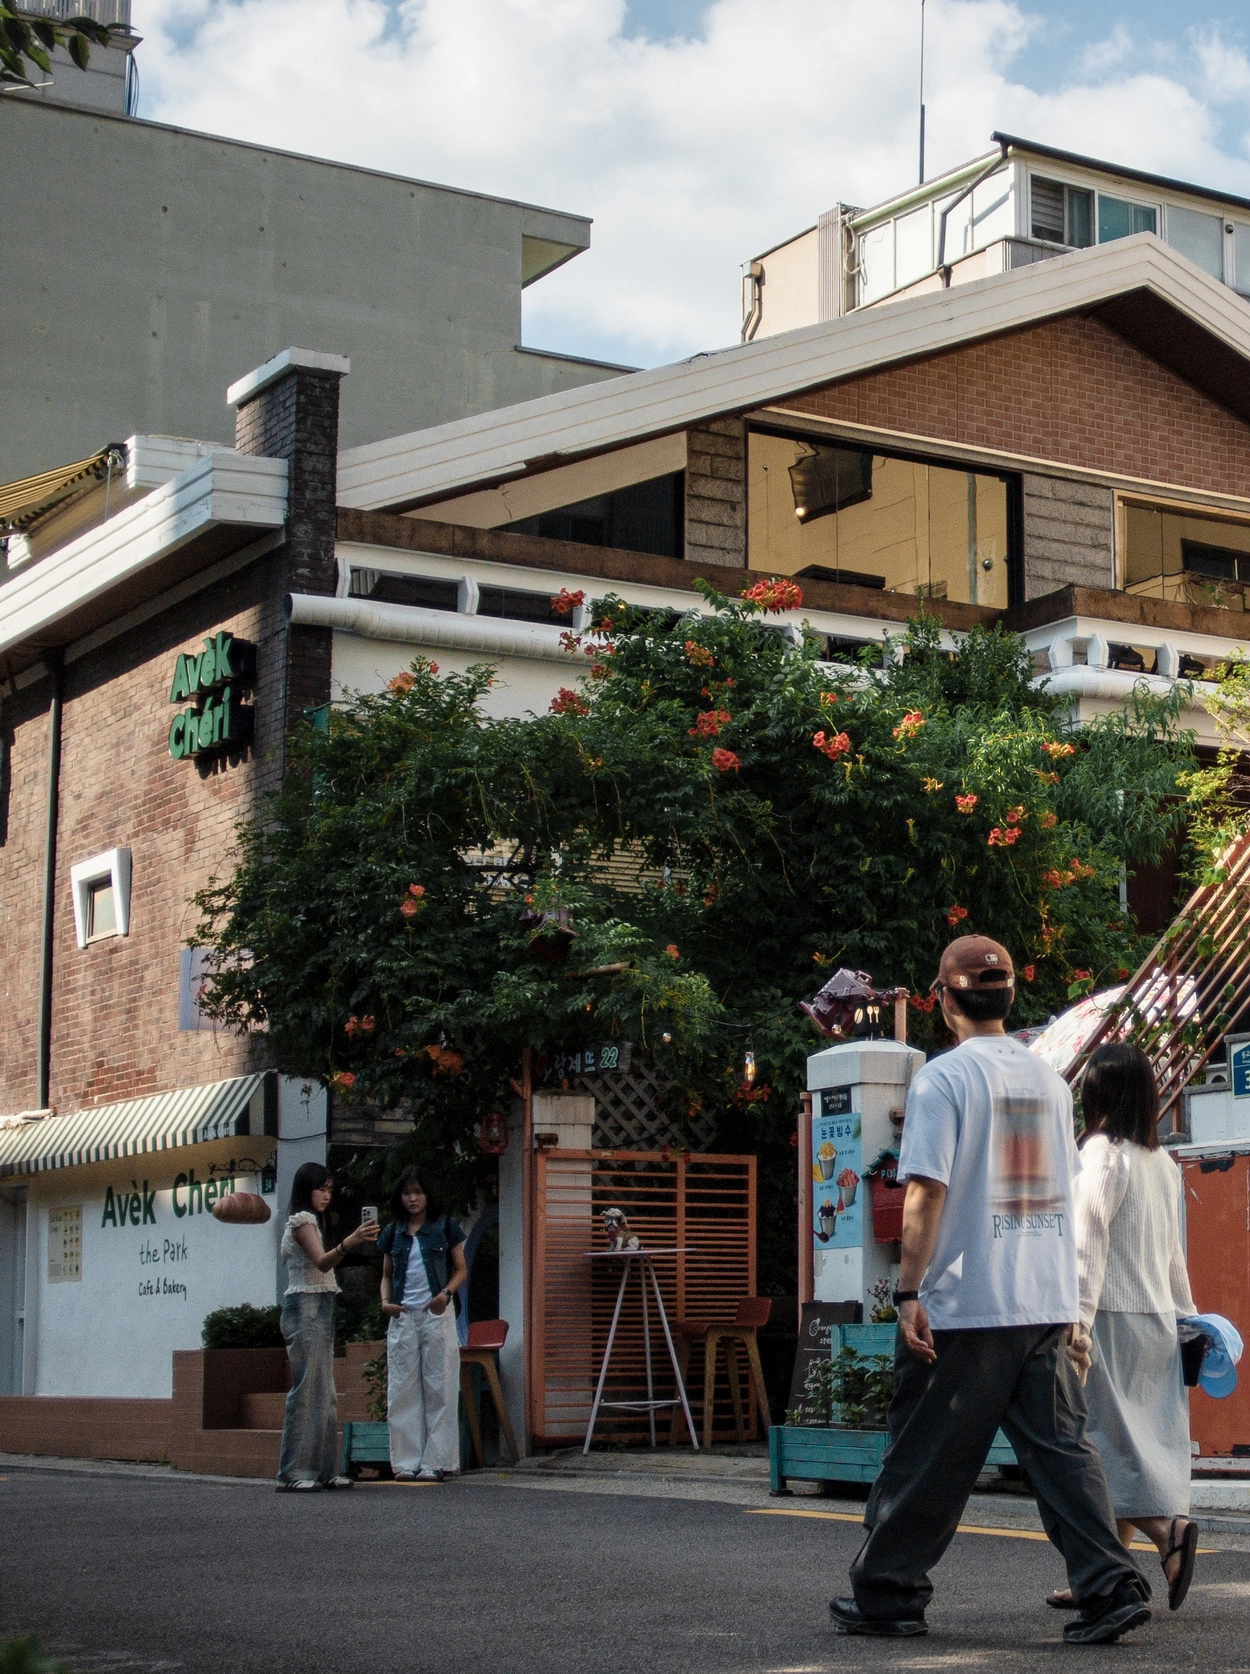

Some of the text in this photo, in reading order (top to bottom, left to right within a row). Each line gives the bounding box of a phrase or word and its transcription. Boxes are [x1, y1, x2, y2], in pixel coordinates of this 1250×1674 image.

[170, 631, 232, 703] Avèk
[169, 686, 230, 759] Chéri
[600, 1046, 619, 1069] 22
[881, 1168, 897, 1180] POS
[101, 1179, 157, 1228] Avèk
[992, 1212, 1065, 1239] RISING SUNSET
[139, 1234, 188, 1265] the Park
[138, 1279, 154, 1296] Cafe
[163, 1277, 187, 1302] Bakery
